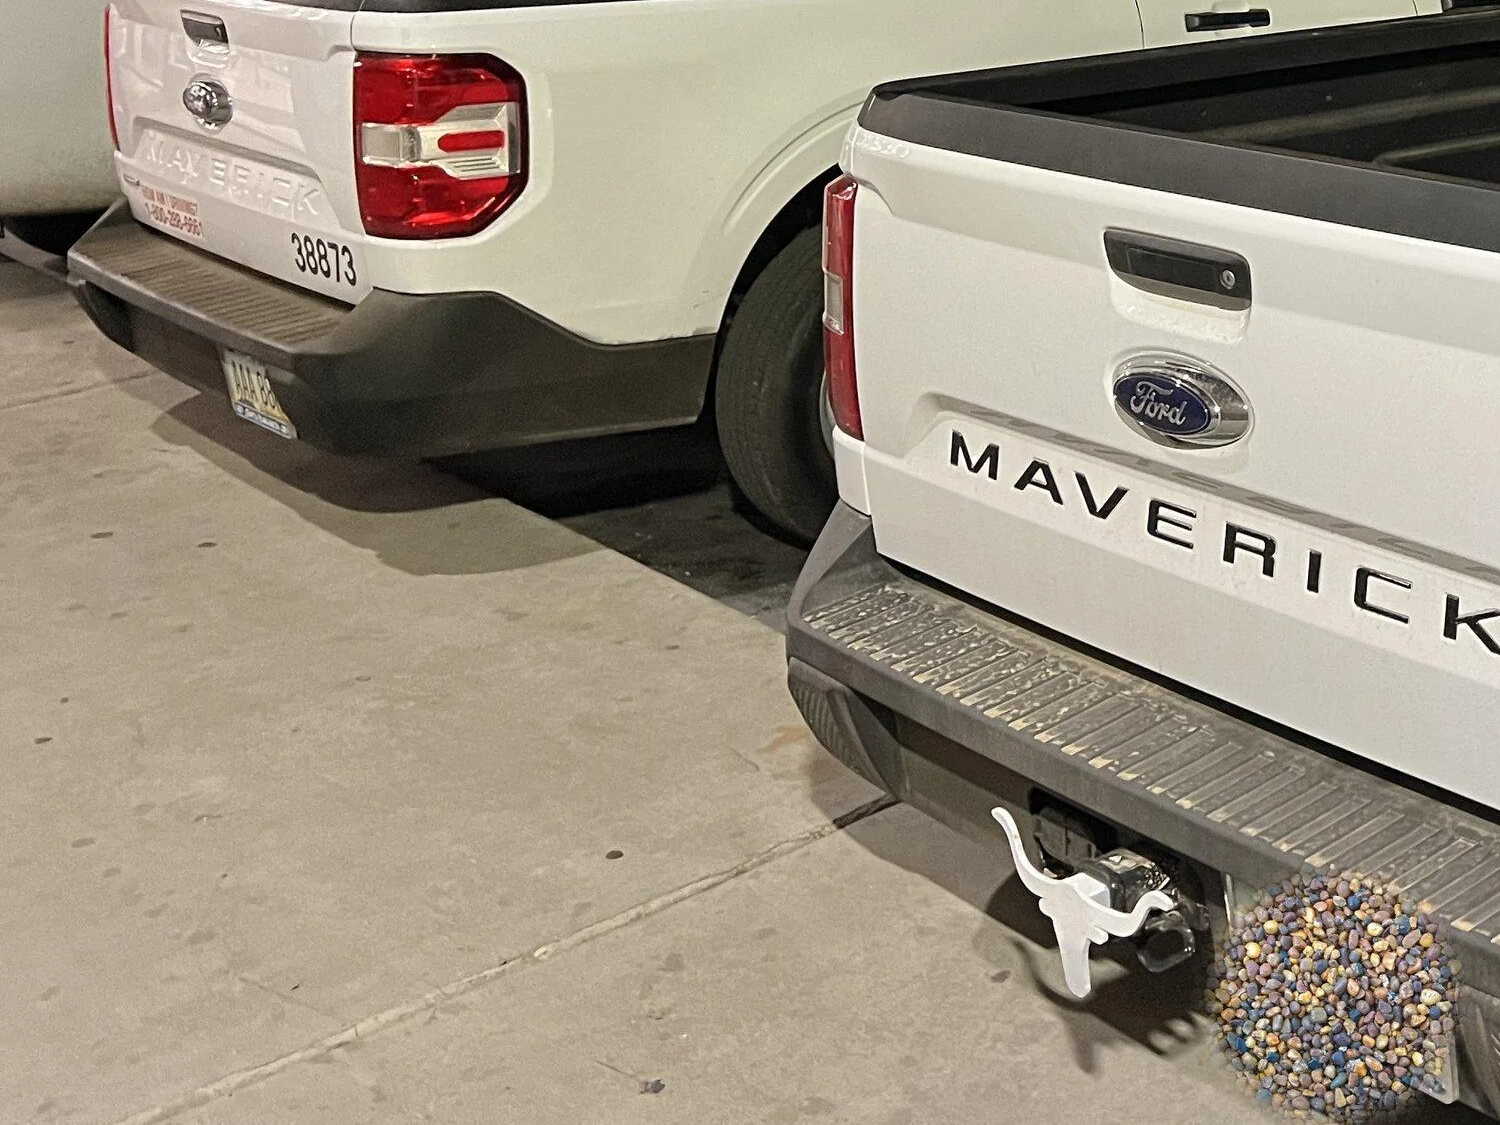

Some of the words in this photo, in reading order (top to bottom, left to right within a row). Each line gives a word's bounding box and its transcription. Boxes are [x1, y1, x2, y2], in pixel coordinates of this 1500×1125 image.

[146, 138, 320, 216] MAVERICK
[291, 232, 357, 287] 38873
[1130, 380, 1188, 426] Ford
